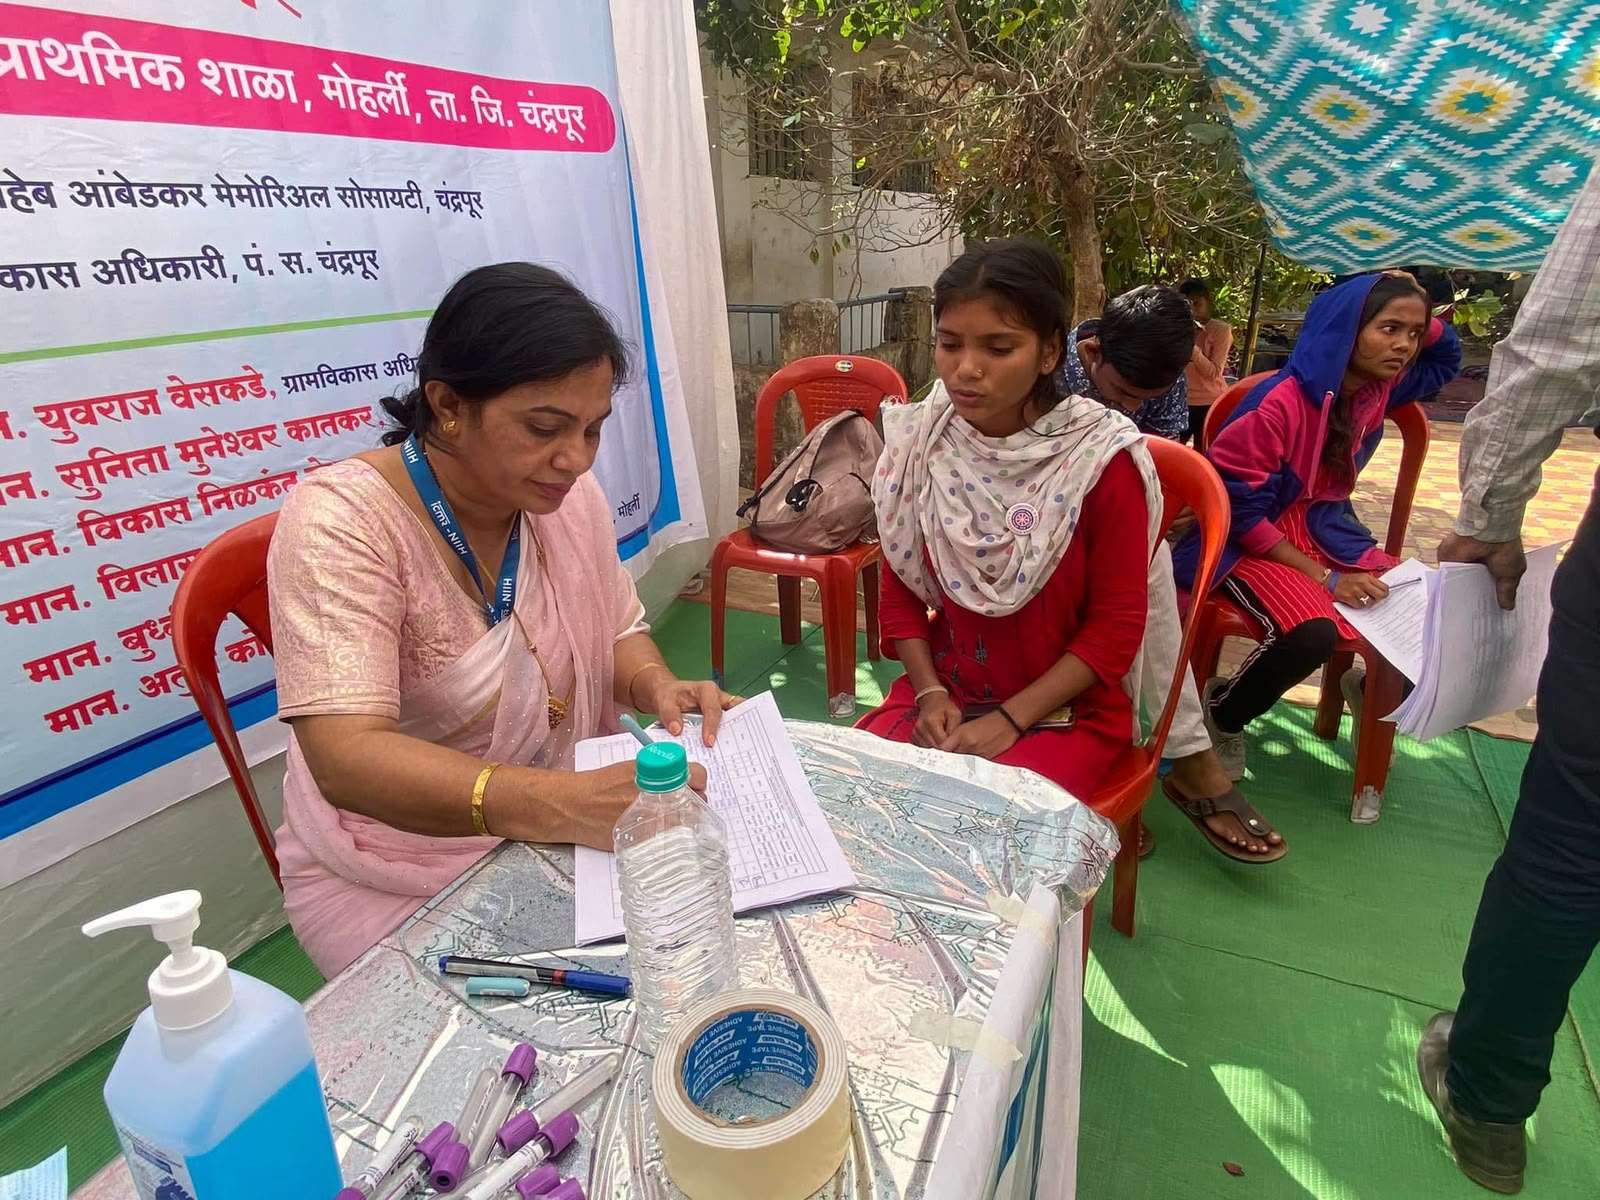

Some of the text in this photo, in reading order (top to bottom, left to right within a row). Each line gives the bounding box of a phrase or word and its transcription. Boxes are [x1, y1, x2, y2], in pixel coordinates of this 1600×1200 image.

[426, 89, 467, 123] ता.
[471, 85, 513, 128] जि.
[517, 90, 587, 143] चंद्रपूर
[68, 168, 207, 208] आंबेडकर
[211, 173, 331, 208] मेमोरिअल
[434, 181, 485, 219] चंद्रपूर
[91, 244, 238, 285] अधिकारी,
[242, 241, 274, 277] पं.
[278, 251, 312, 275] स.
[316, 240, 380, 281] चंद्रपूर
[33, 388, 162, 445] युवराज
[166, 364, 277, 410] वेसकडे,
[281, 363, 378, 395] ग्रामविकास
[55, 446, 170, 501] सुनिता
[174, 426, 282, 476] मुनेश्वर
[77, 496, 193, 546] विकास
[0, 584, 92, 626] मान.
[23, 640, 112, 683] मान.
[44, 689, 130, 733] मान.
